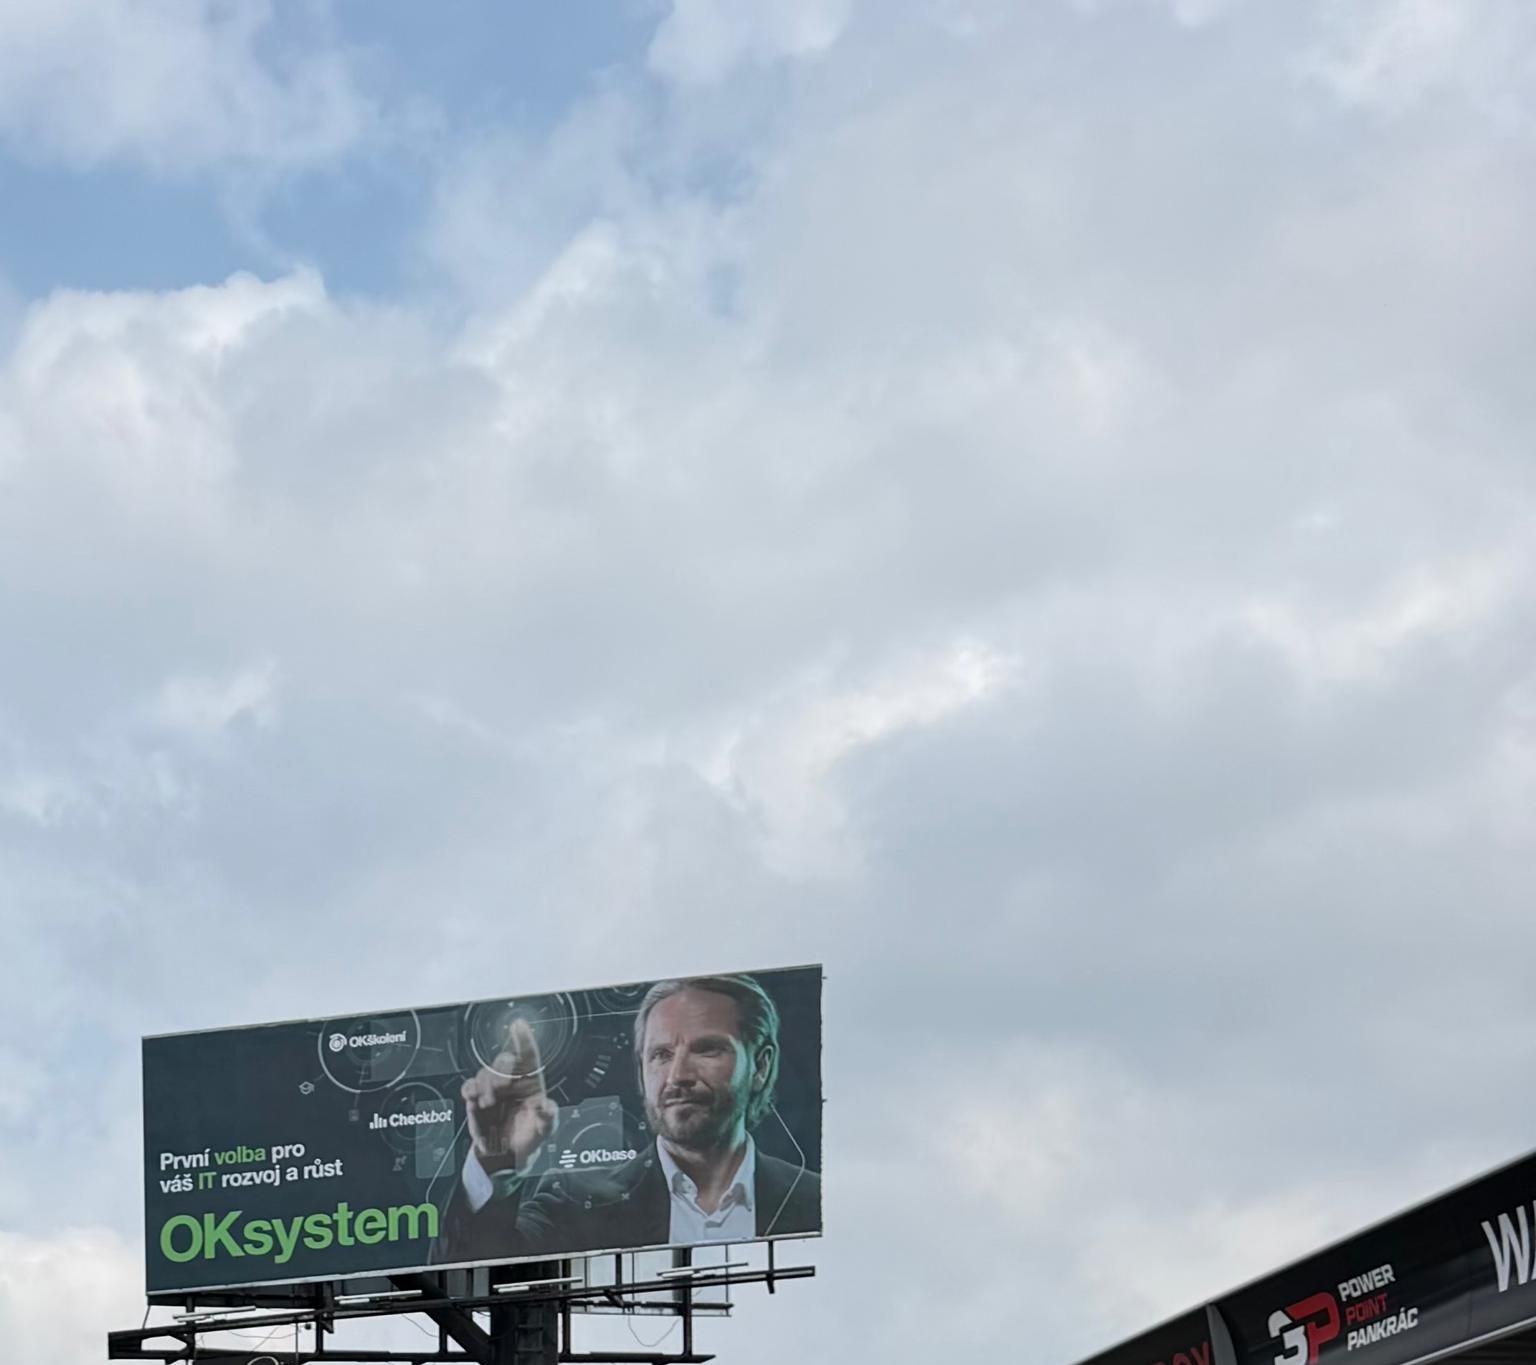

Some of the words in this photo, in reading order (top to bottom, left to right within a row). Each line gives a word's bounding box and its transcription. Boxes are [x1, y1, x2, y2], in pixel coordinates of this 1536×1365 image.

[389, 1109, 452, 1127] Checkbot
[159, 1148, 211, 1171] První
[214, 1145, 266, 1166] volba
[271, 1142, 305, 1161] pro
[579, 1149, 637, 1164] OKbase
[159, 1173, 194, 1193] váš
[198, 1171, 217, 1190] IT
[221, 1165, 281, 1188] rozvoj
[285, 1166, 299, 1181] a
[303, 1158, 344, 1180] růst
[160, 1201, 439, 1264] OKsystem
[1337, 1263, 1396, 1302] POWER
[1344, 1292, 1388, 1327] POINT
[1347, 1307, 1419, 1351] PANKRÁC
